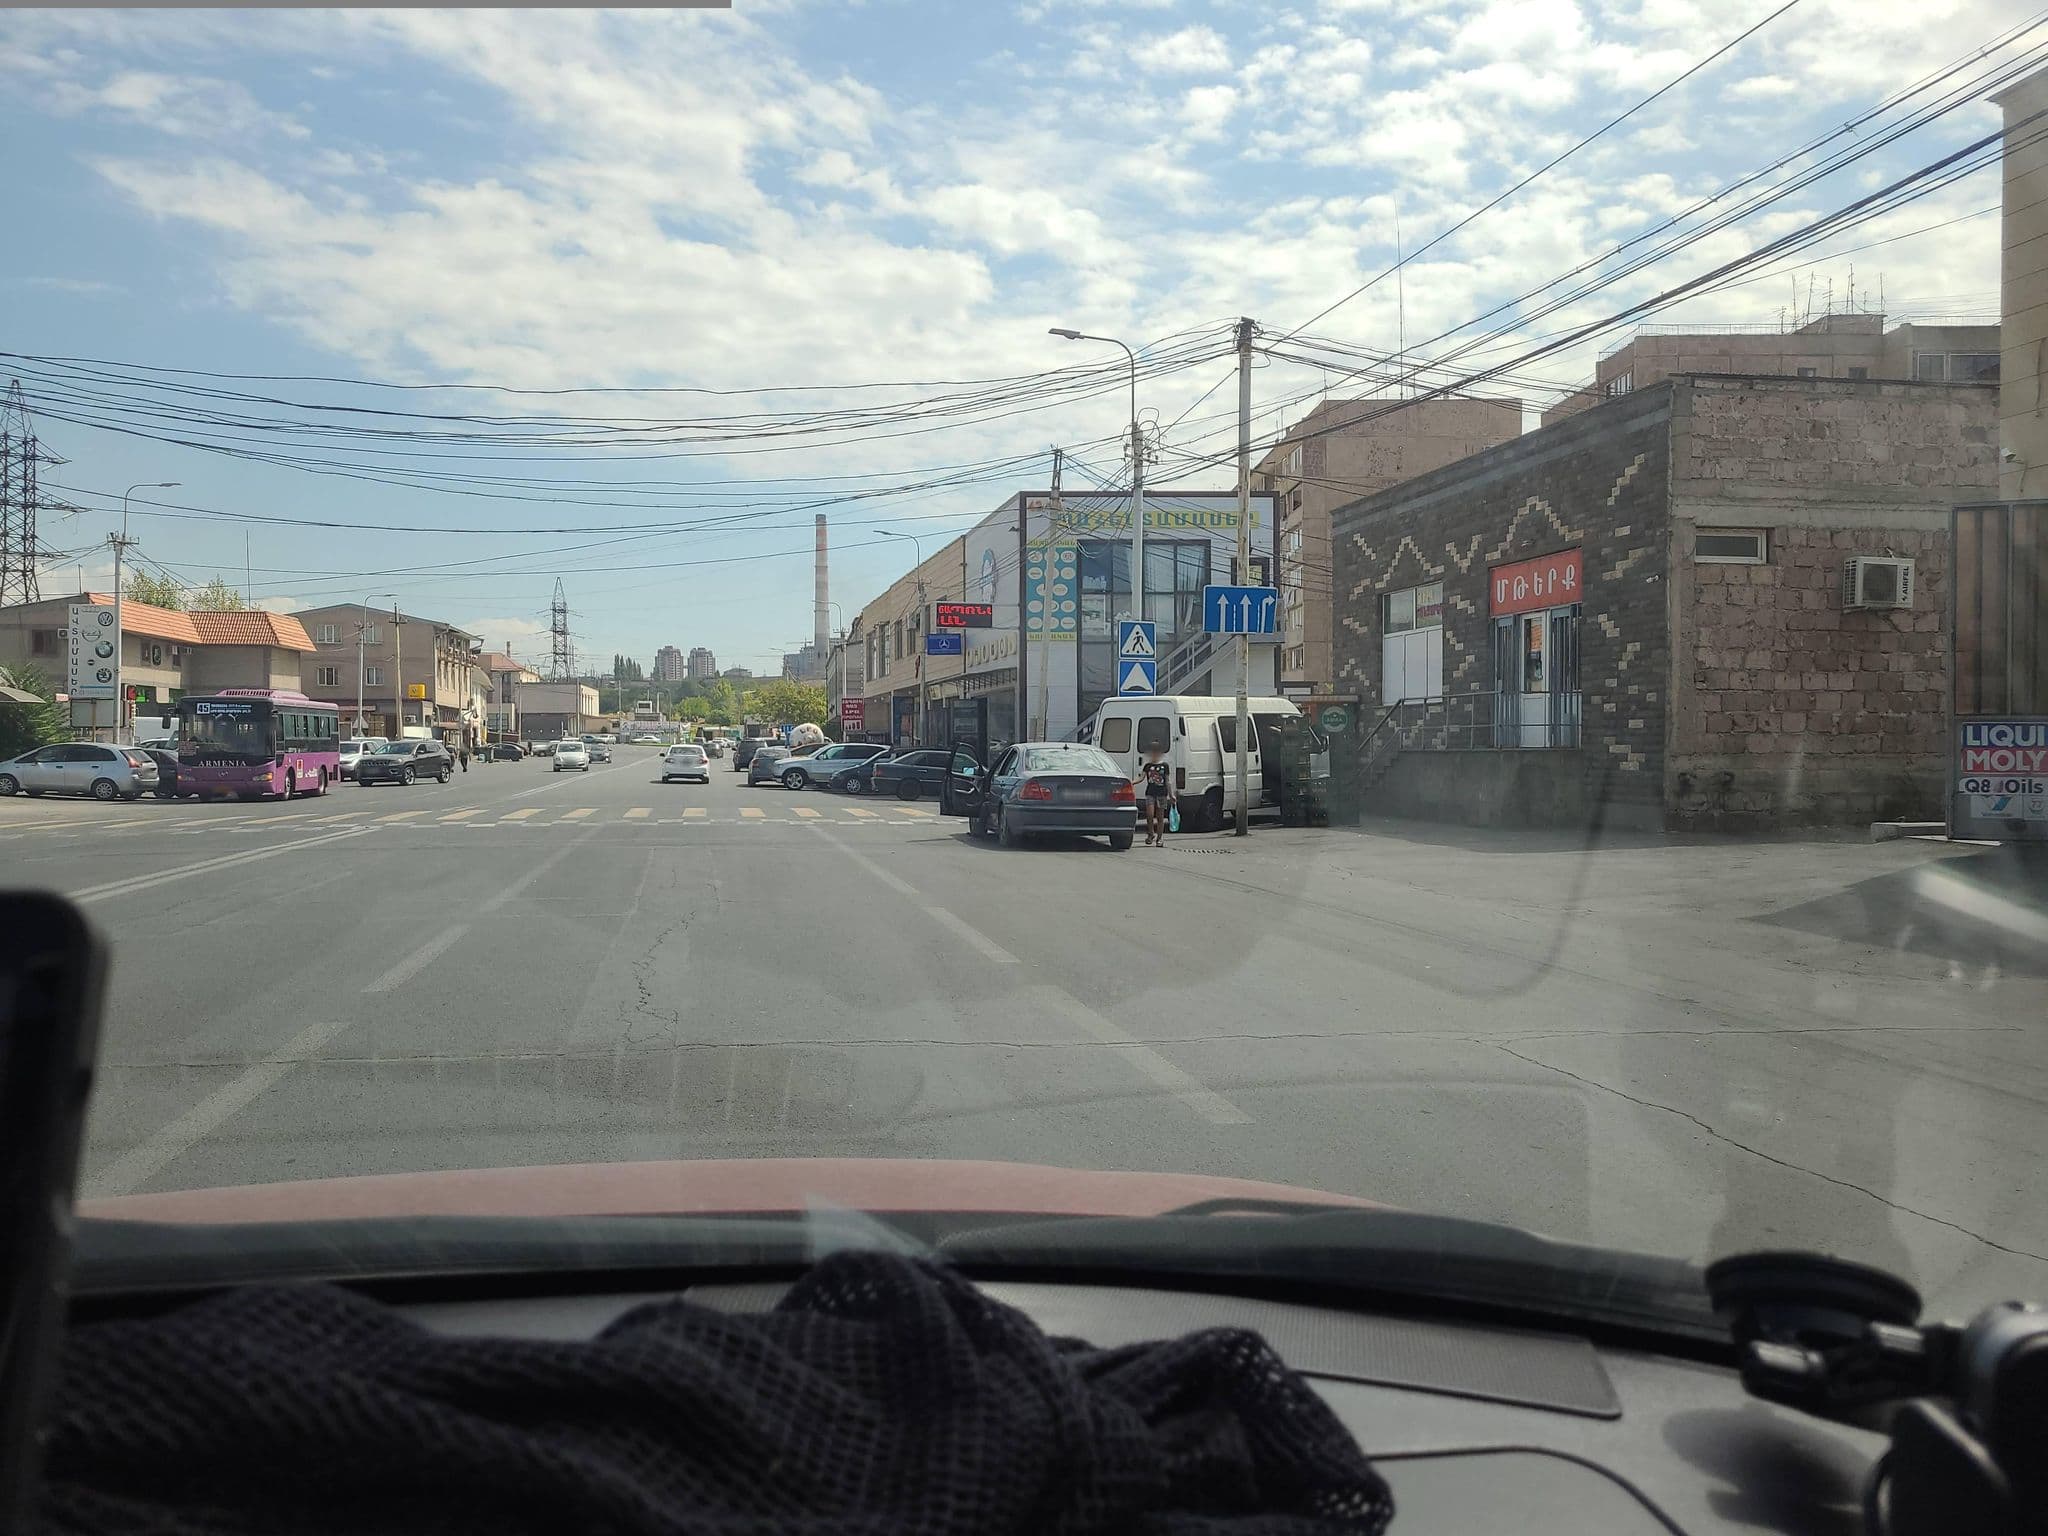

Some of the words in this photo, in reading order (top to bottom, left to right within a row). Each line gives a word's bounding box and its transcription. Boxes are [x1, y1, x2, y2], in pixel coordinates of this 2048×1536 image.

[1497, 564, 1576, 604] ՄԹԵՐՔ
[71, 607, 80, 696] ԱՎՏՈՄԱՍԵՐ
[198, 704, 209, 713] 45
[1966, 724, 2046, 748] LIQUI
[198, 760, 247, 768] ARMENIA
[1966, 749, 2047, 771] MOLY
[1965, 778, 1991, 794] Q8
[2004, 778, 2044, 794] Oils
